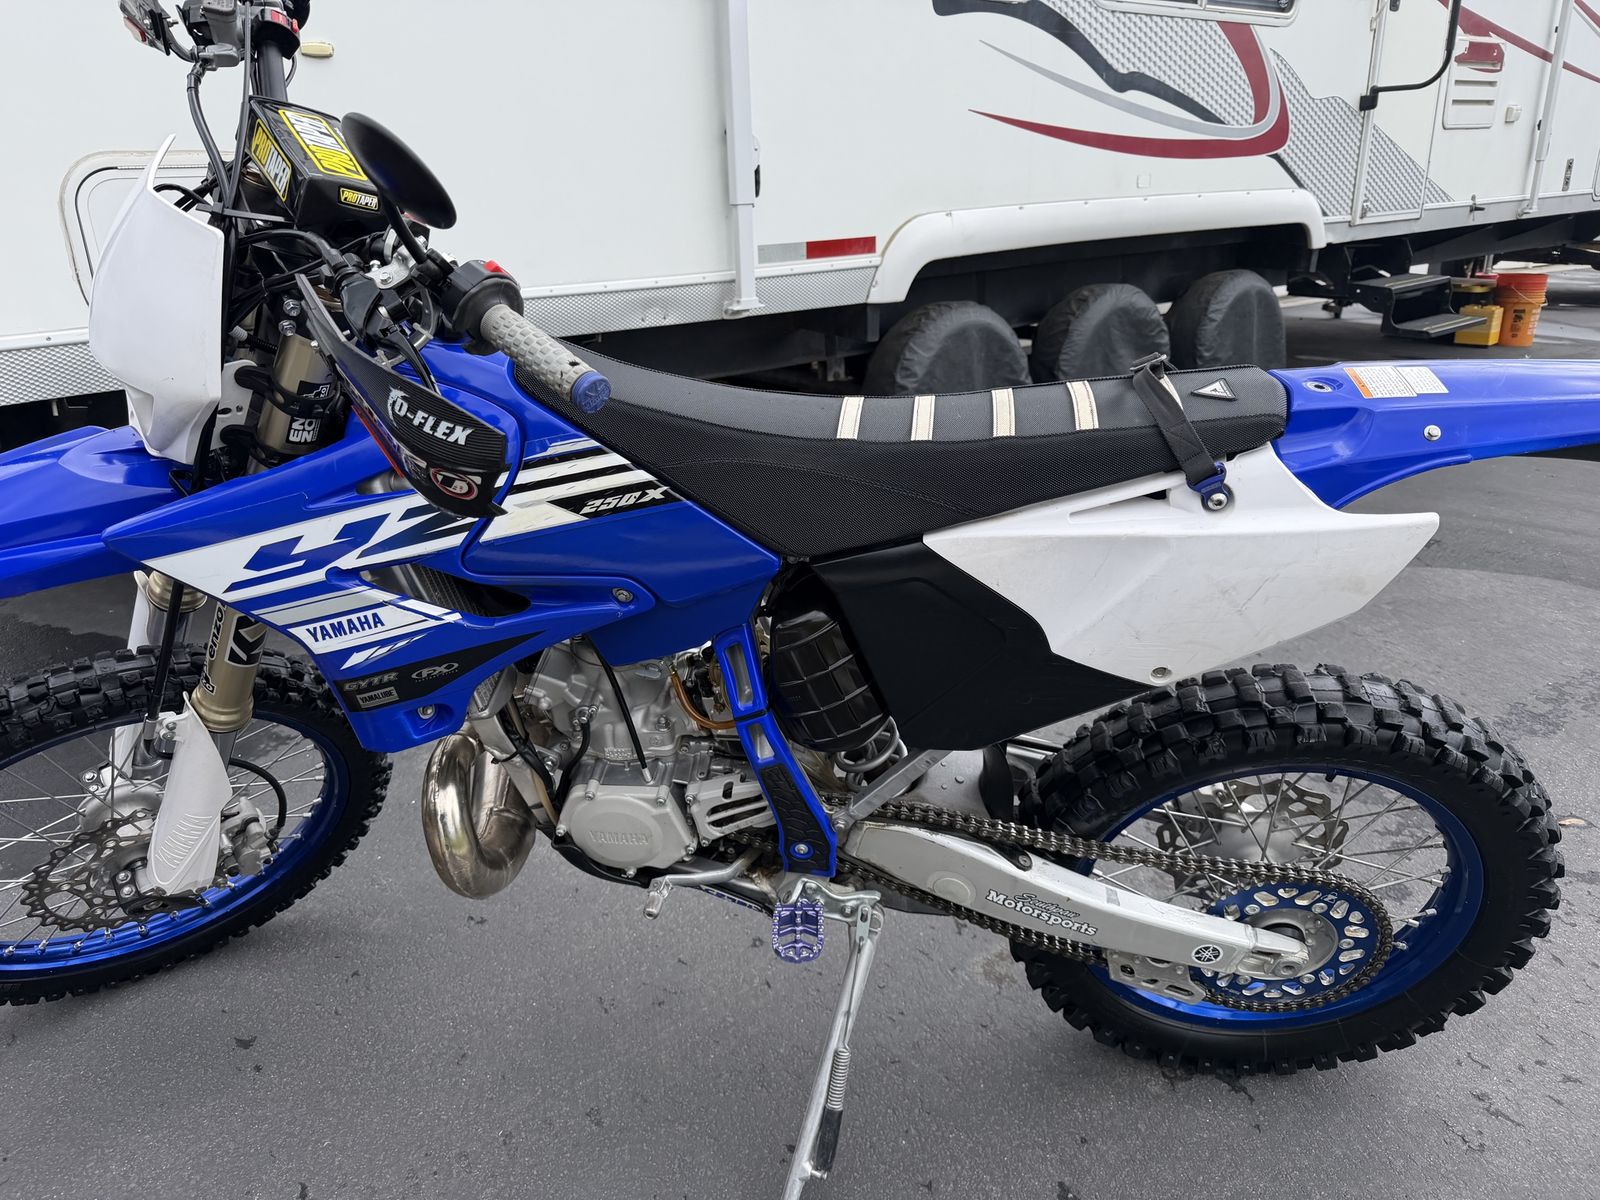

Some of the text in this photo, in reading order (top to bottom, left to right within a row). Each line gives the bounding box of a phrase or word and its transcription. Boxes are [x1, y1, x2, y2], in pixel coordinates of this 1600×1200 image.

[253, 126, 290, 197] PROTAPER
[343, 190, 378, 208] PROTAPER
[579, 486, 670, 515] 250X
[305, 612, 386, 643] YAMAHA
[343, 671, 400, 692] GYTR
[359, 688, 396, 705] YAMALUBE
[588, 830, 651, 846] YAMAHA
[984, 888, 1099, 937] Motorsports
